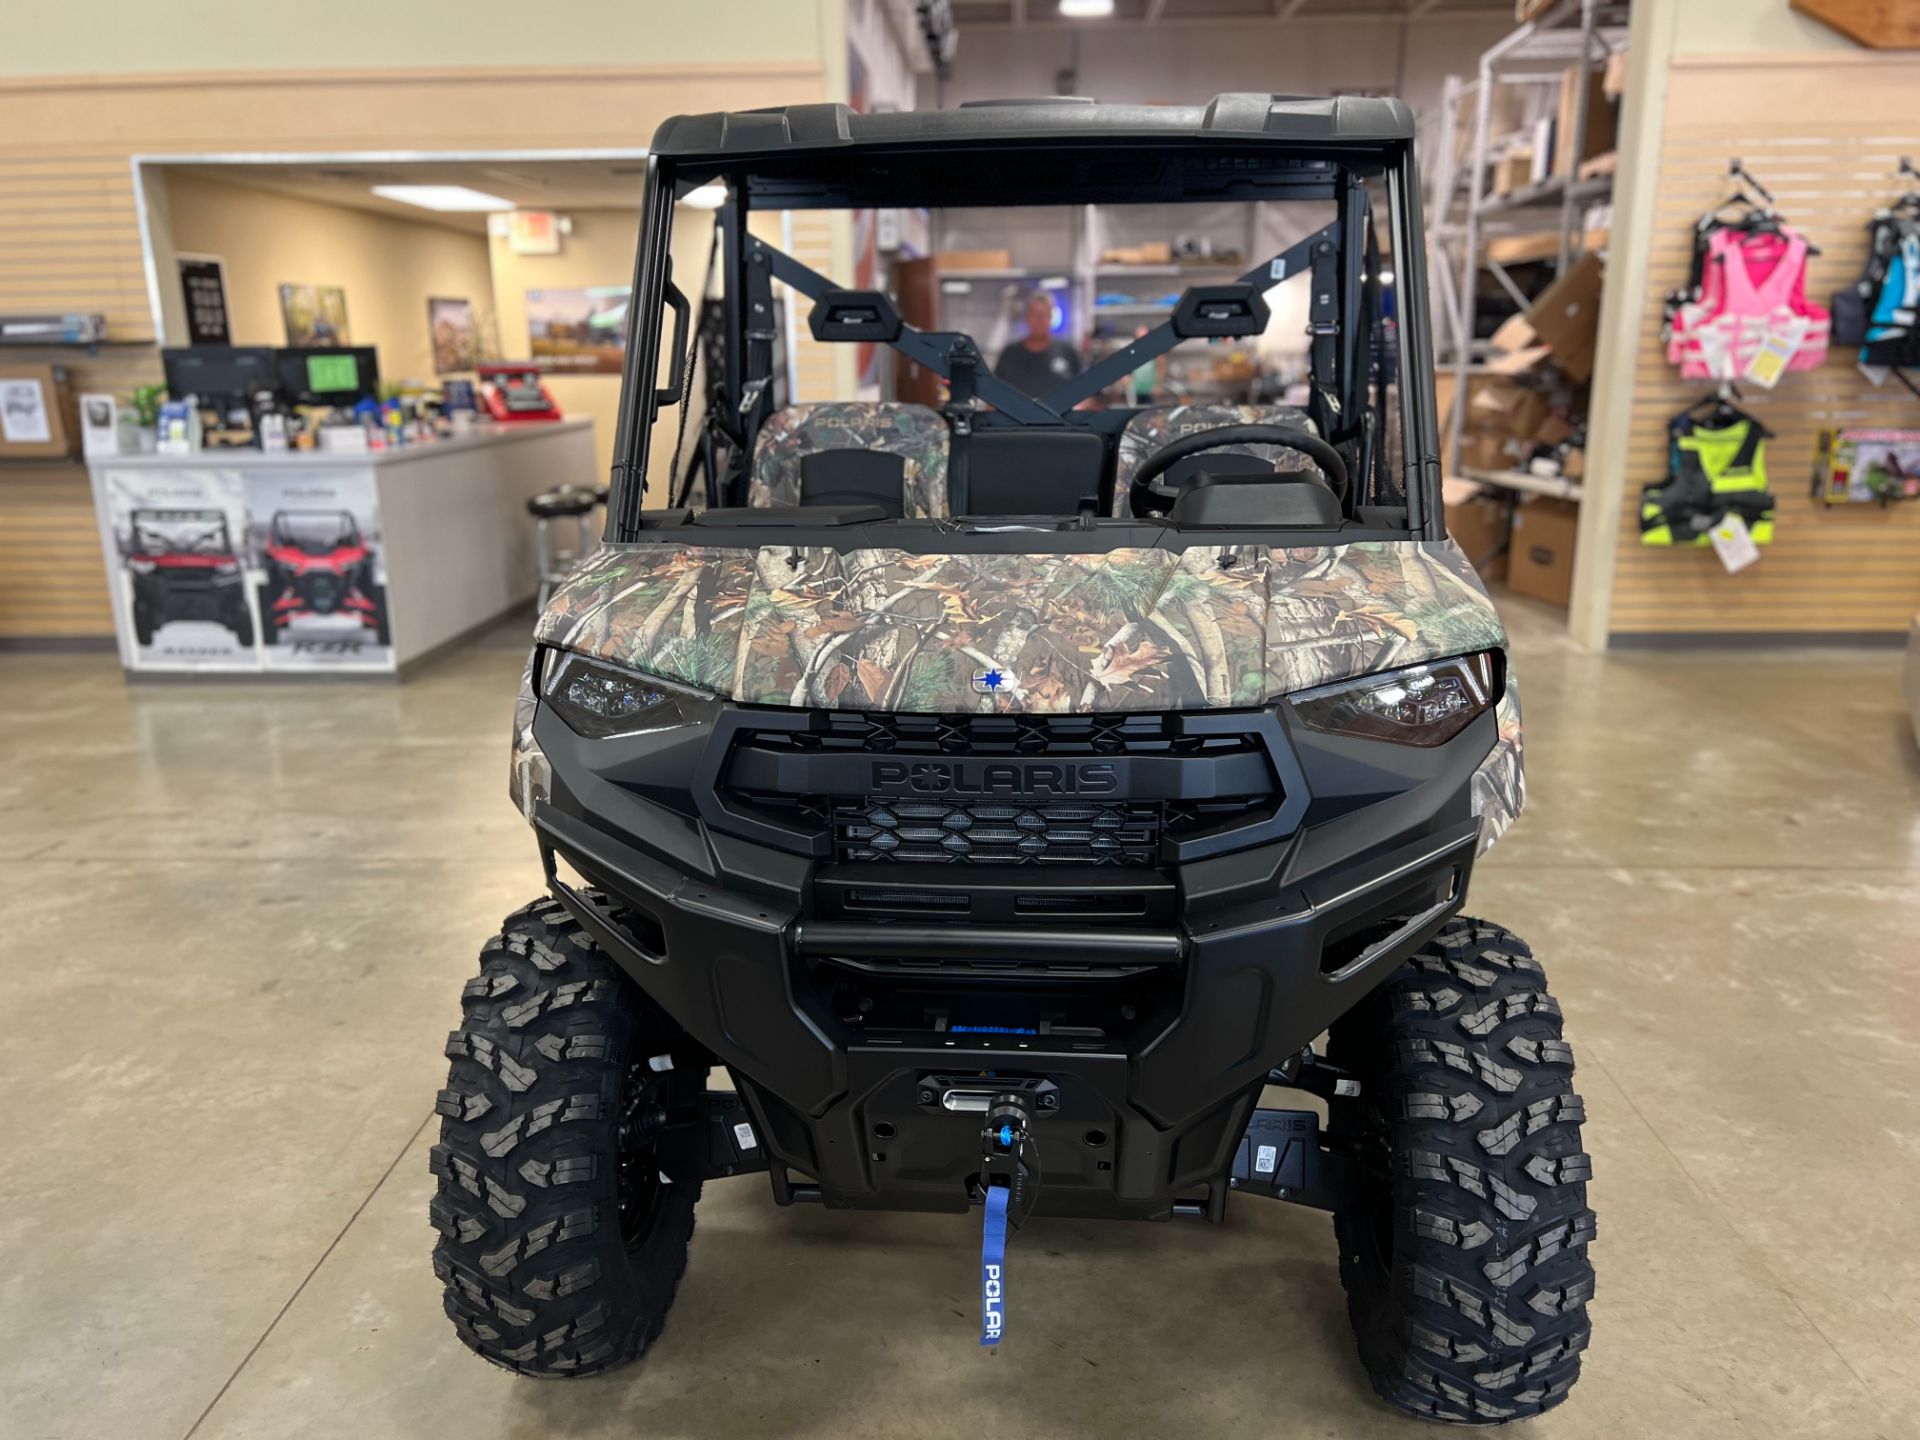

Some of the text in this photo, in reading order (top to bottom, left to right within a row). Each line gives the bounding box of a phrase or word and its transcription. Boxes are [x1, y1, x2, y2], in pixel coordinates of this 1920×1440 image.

[814, 416, 893, 429] POLARIS
[871, 761, 1118, 795] POLARIS
[985, 1264, 1001, 1339] POLAR
